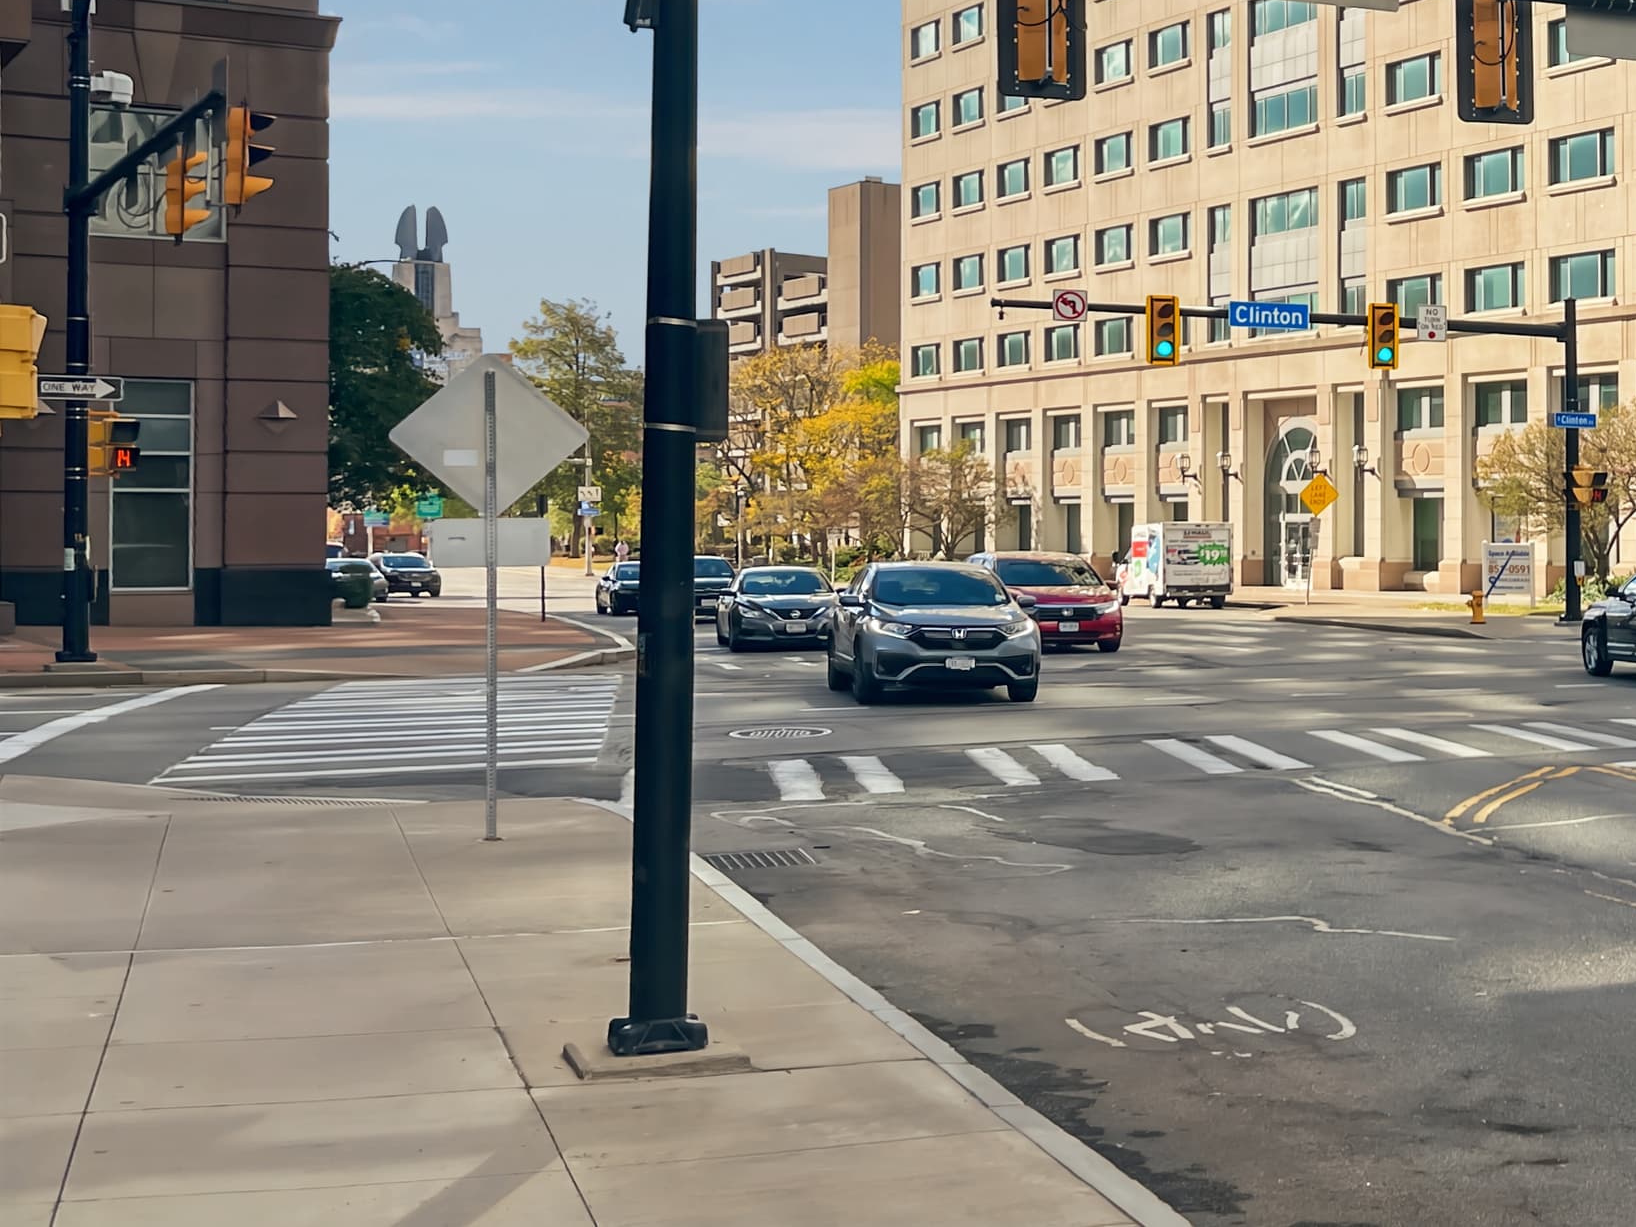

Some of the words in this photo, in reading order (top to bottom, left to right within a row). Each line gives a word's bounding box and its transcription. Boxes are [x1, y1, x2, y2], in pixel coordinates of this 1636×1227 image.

[1235, 305, 1303, 325] Clinton
[43, 383, 64, 391] ONE
[72, 384, 96, 392] WAY
[1561, 415, 1588, 426] Clinton
